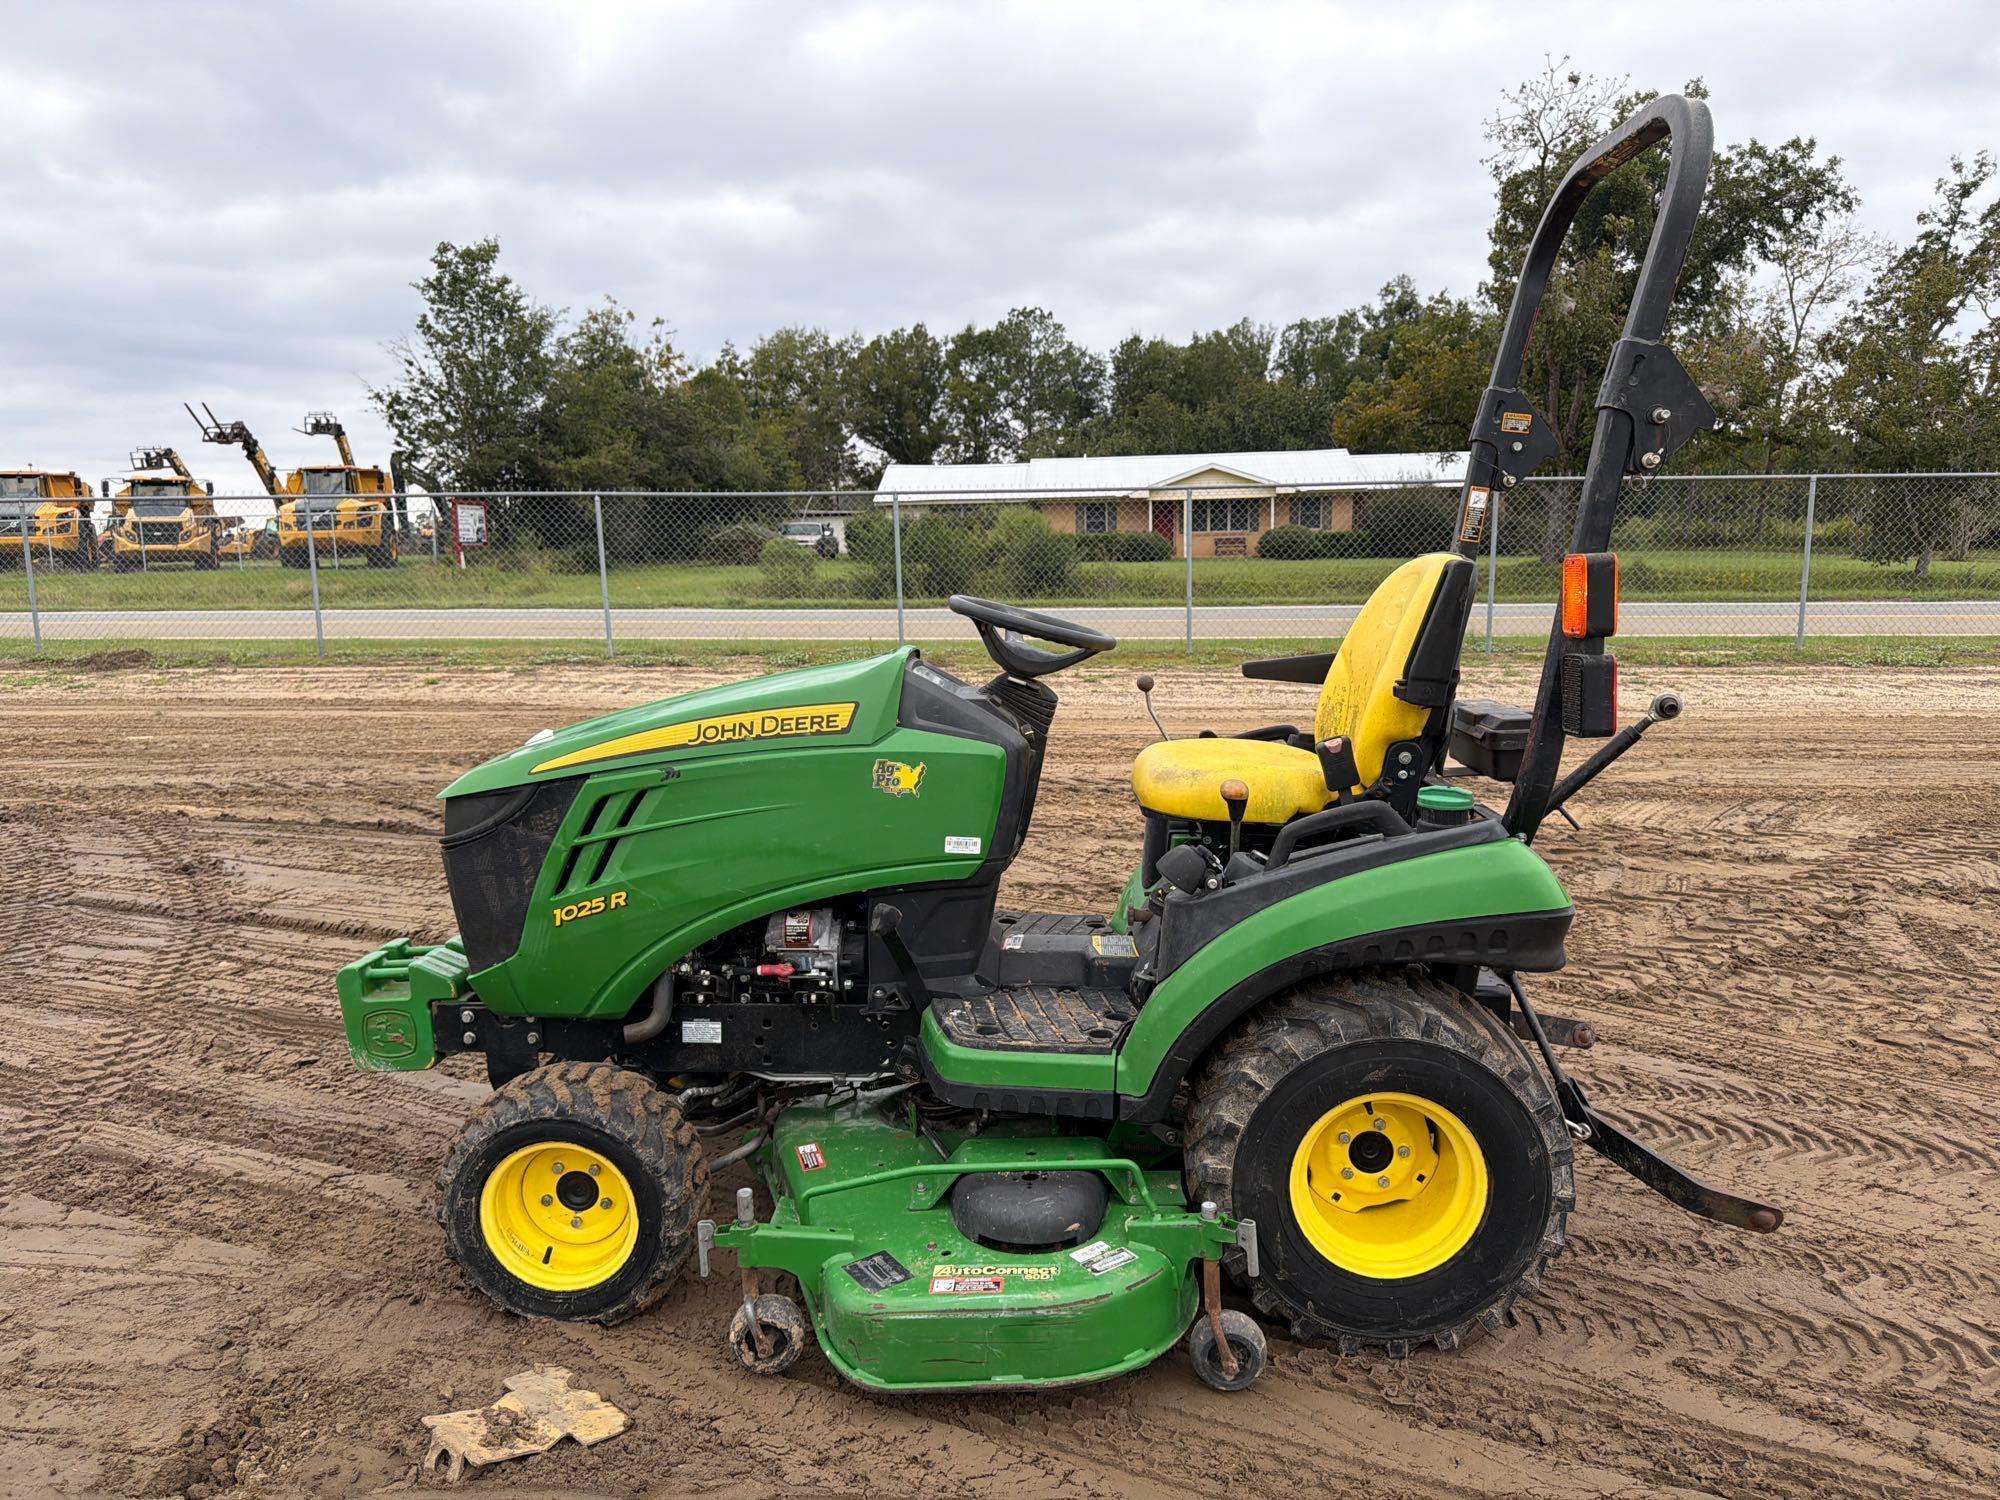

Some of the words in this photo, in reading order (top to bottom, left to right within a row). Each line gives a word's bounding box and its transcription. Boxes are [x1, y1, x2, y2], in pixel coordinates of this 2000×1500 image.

[687, 720, 754, 743] JOHN
[761, 713, 839, 734] DEERE
[875, 760, 901, 776] Ag-
[875, 774, 900, 787] Pro
[553, 896, 606, 927] 1025
[610, 891, 628, 909] R
[934, 1264, 1058, 1276] AutoConnect
[1024, 1273, 1051, 1281] 60D
